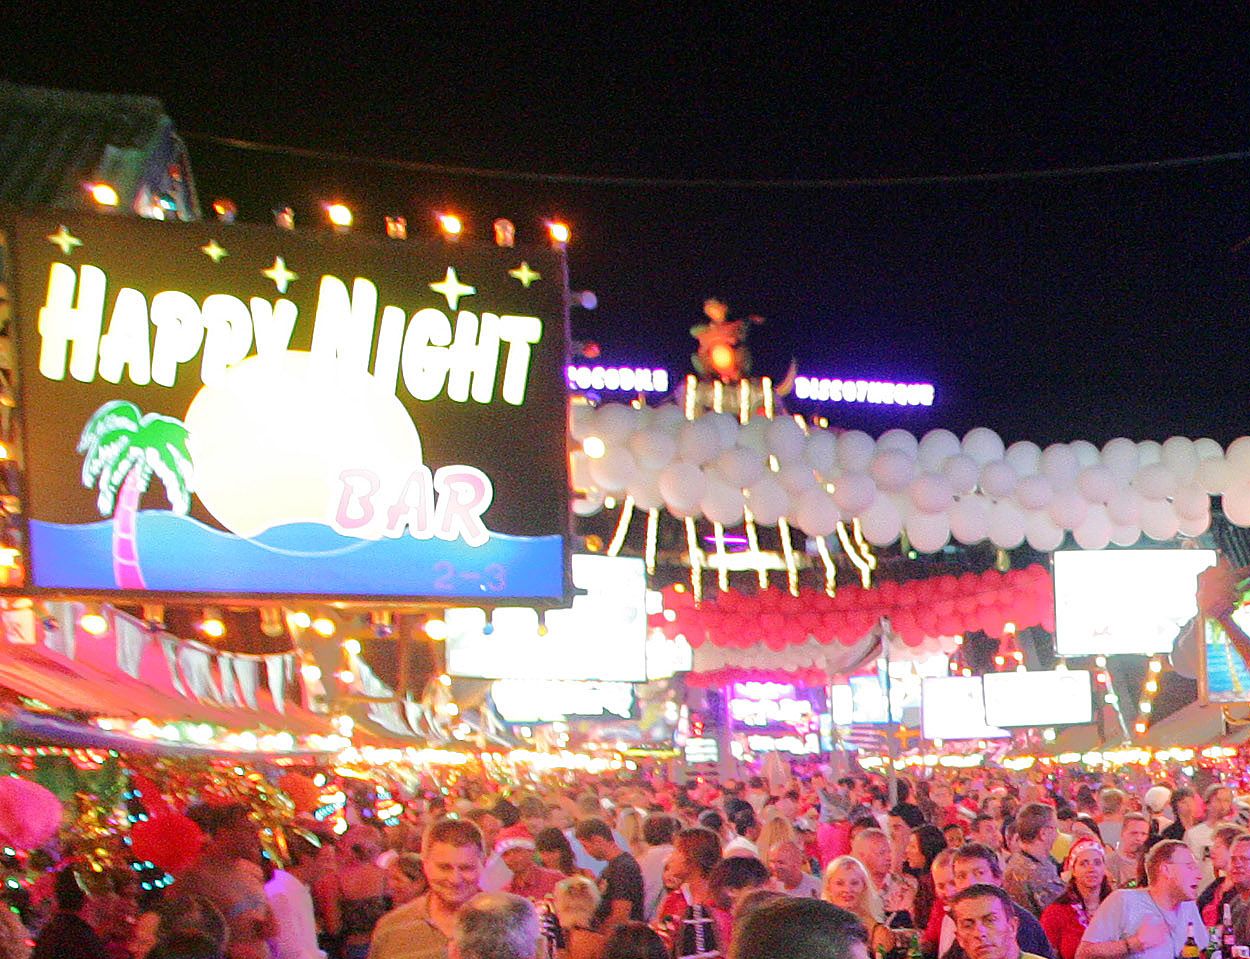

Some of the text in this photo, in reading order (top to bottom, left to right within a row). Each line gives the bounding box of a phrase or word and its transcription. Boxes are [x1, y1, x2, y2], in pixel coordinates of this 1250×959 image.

[38, 262, 543, 406] HAPPY NIGHT
[332, 465, 491, 544] BAR
[434, 561, 507, 592] 2-3
